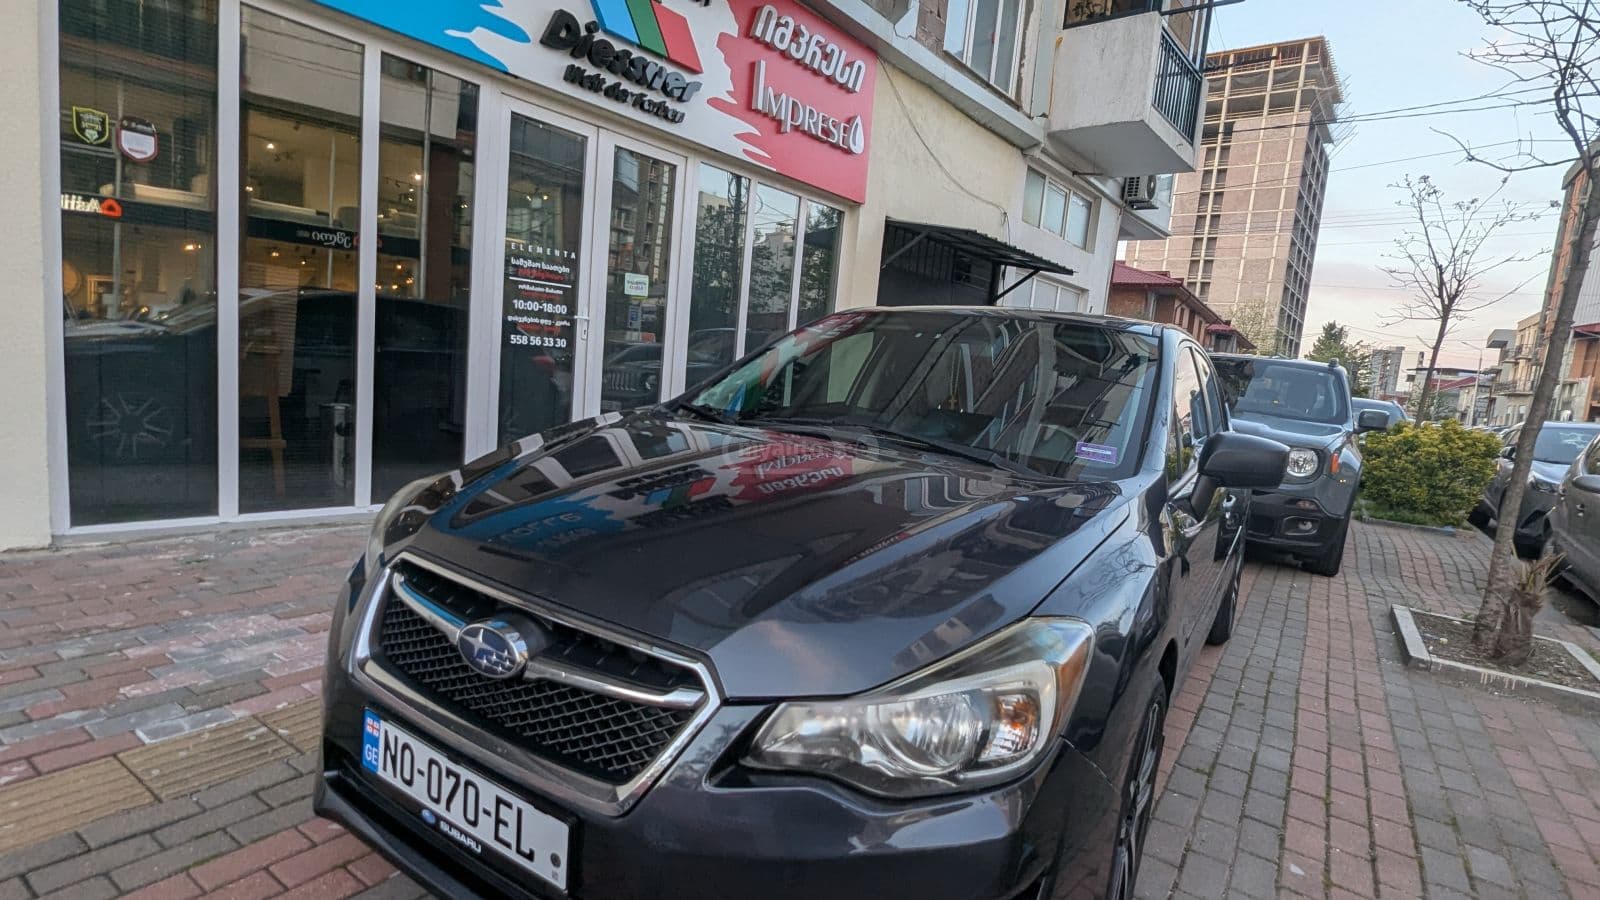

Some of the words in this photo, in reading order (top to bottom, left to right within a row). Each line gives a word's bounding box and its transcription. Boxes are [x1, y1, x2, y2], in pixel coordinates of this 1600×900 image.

[511, 242, 576, 259] ELEMENTA
[513, 299, 567, 315] 10:00-18:00
[510, 335, 528, 345] 558
[529, 336, 541, 346] 56
[543, 338, 554, 347] 33
[555, 338, 566, 348] 30
[365, 743, 378, 765] GE
[382, 729, 535, 863] NO-070-EL
[439, 820, 481, 854] SUBARU
